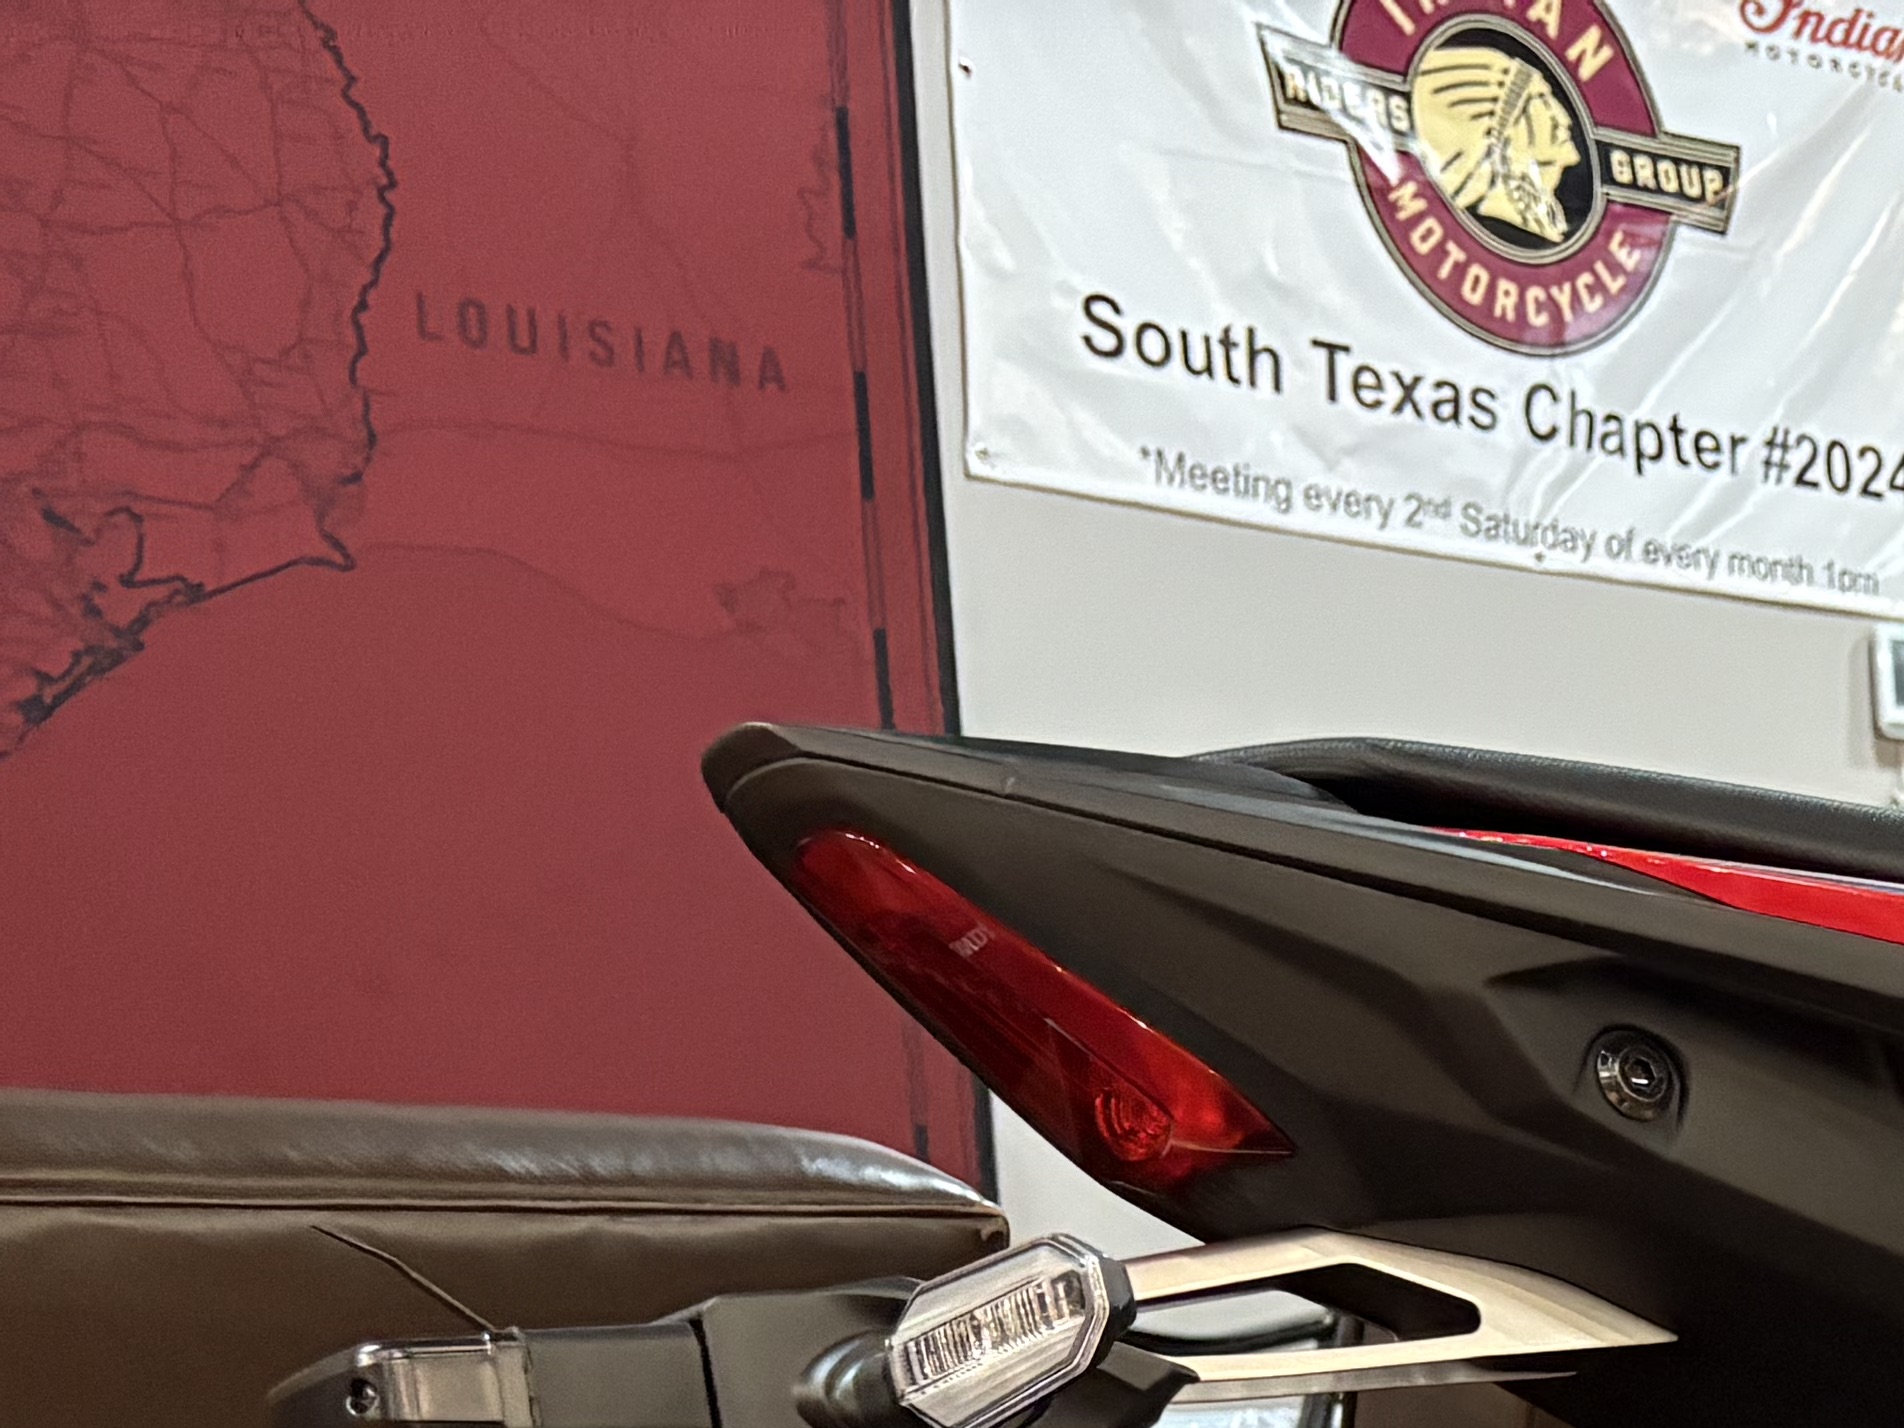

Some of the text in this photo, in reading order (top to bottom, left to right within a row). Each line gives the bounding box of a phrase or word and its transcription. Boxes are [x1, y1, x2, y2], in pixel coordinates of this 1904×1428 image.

[1610, 149, 1723, 207] GROUP
[1387, 180, 1644, 332] MOTORCYCLE
[415, 290, 789, 393] LOUISIANA
[1081, 293, 1283, 395] South
[1311, 337, 1497, 432] Texas
[1524, 382, 1750, 477] Chapter
[1303, 482, 1395, 531] every
[1403, 491, 1452, 531] 2nd
[1460, 501, 1598, 563] Saturday
[1605, 526, 1636, 560] of
[1642, 542, 1721, 581] every
[1728, 549, 1814, 587] month
[1823, 559, 1880, 595] 1pm
